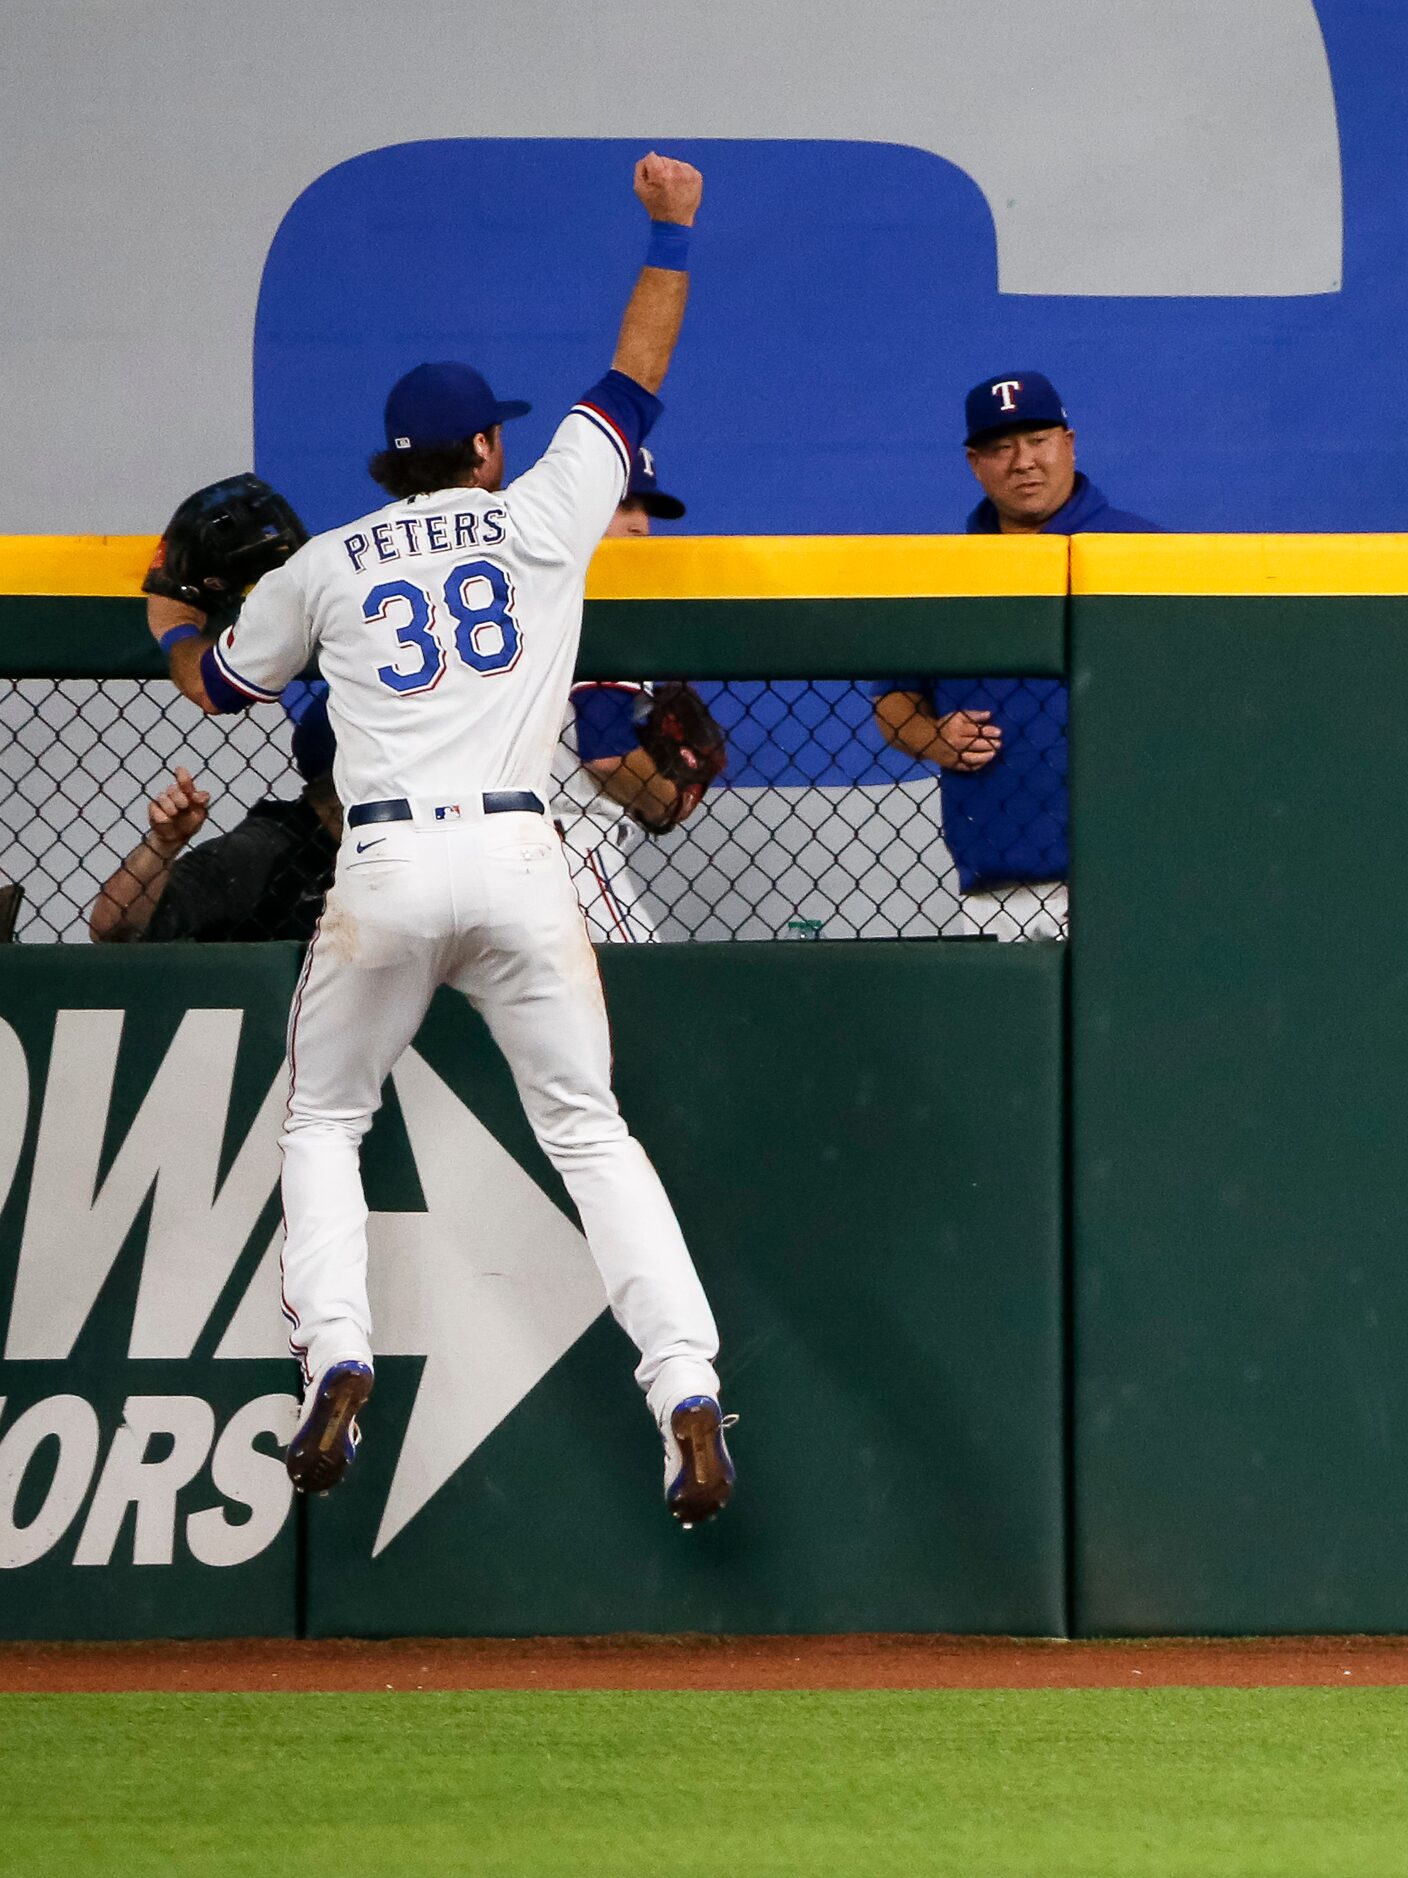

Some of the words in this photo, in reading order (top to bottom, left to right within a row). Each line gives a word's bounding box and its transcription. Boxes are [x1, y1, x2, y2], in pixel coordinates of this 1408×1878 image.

[991, 380, 1022, 412] T
[344, 508, 507, 574] PETERS
[361, 559, 524, 697] 38
[0, 1393, 303, 1569] ORS
